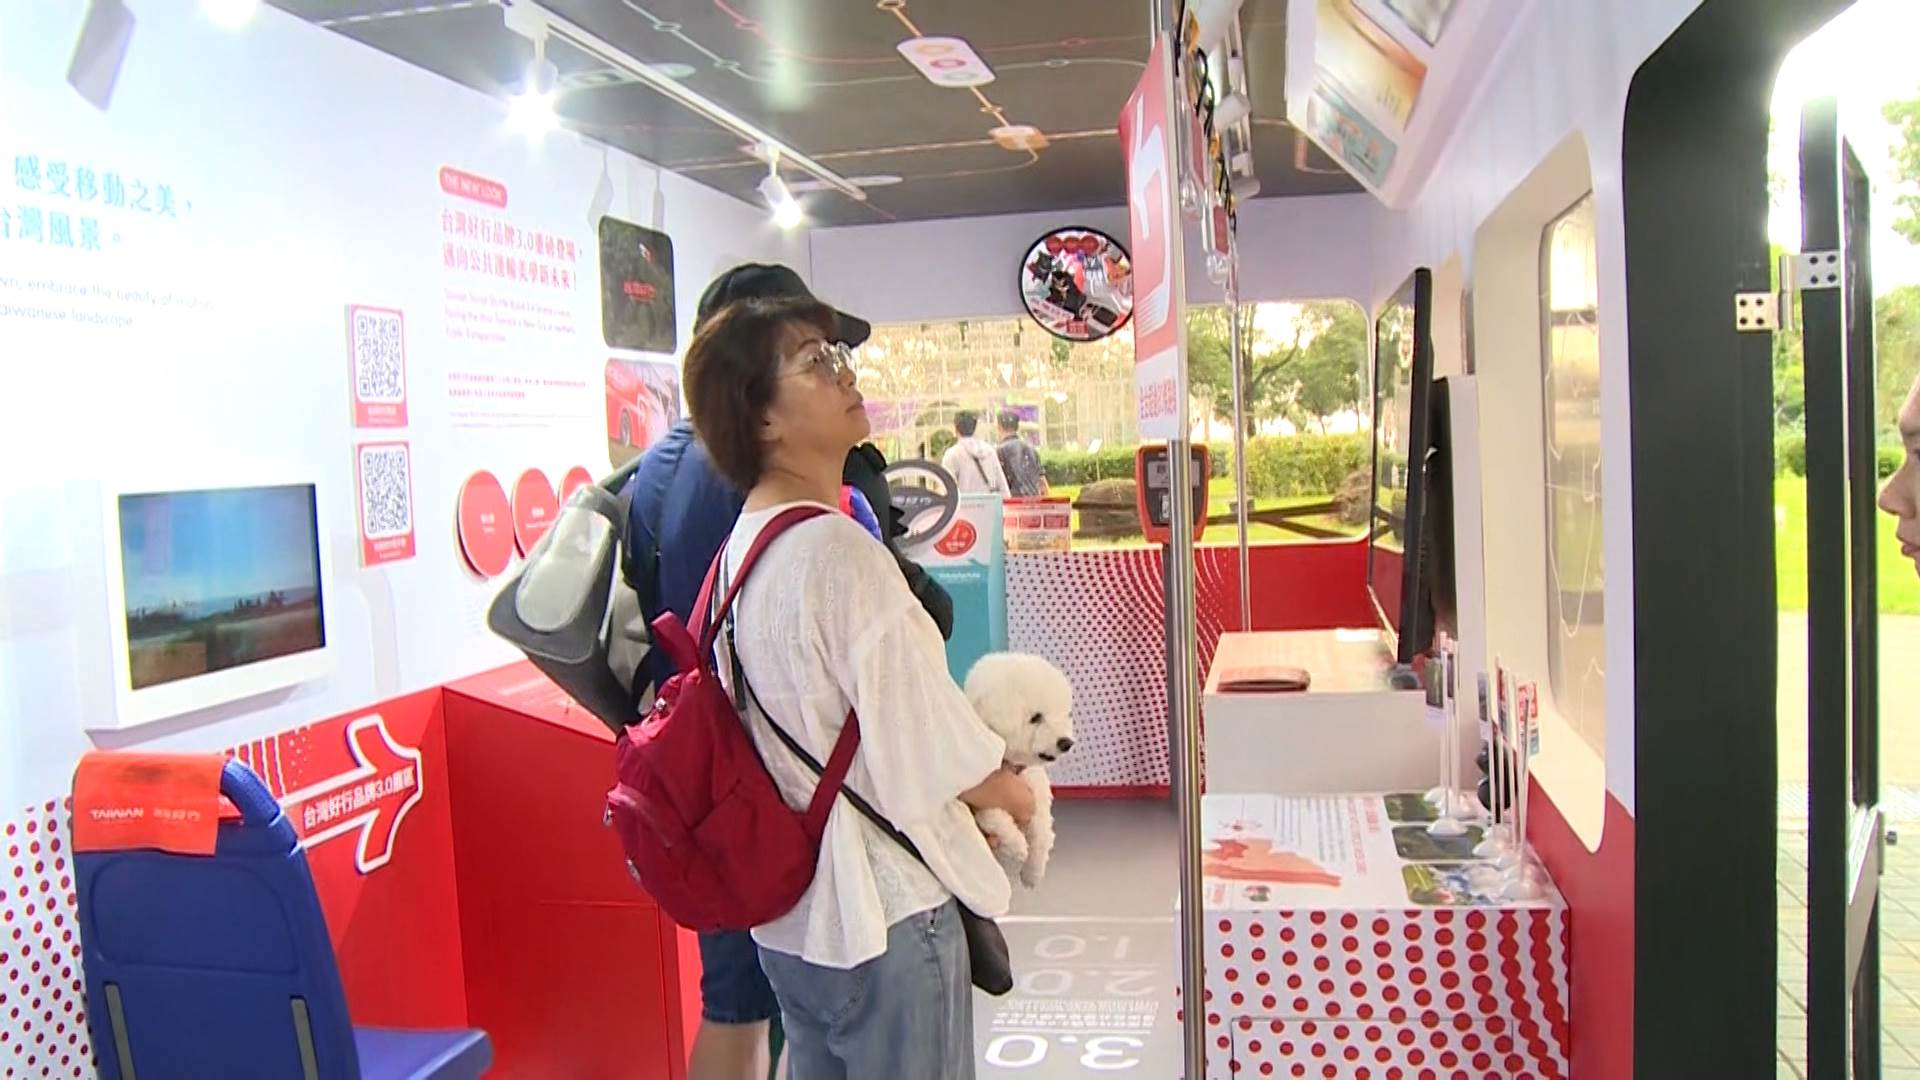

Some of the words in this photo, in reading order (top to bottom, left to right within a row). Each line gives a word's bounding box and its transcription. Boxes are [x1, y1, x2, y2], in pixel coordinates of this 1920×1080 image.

[15, 153, 192, 218] 感受移動之美，
[89, 807, 144, 820] TAIWAN
[1022, 969, 1158, 996] 2.0
[984, 1034, 1144, 1070] 3.0
